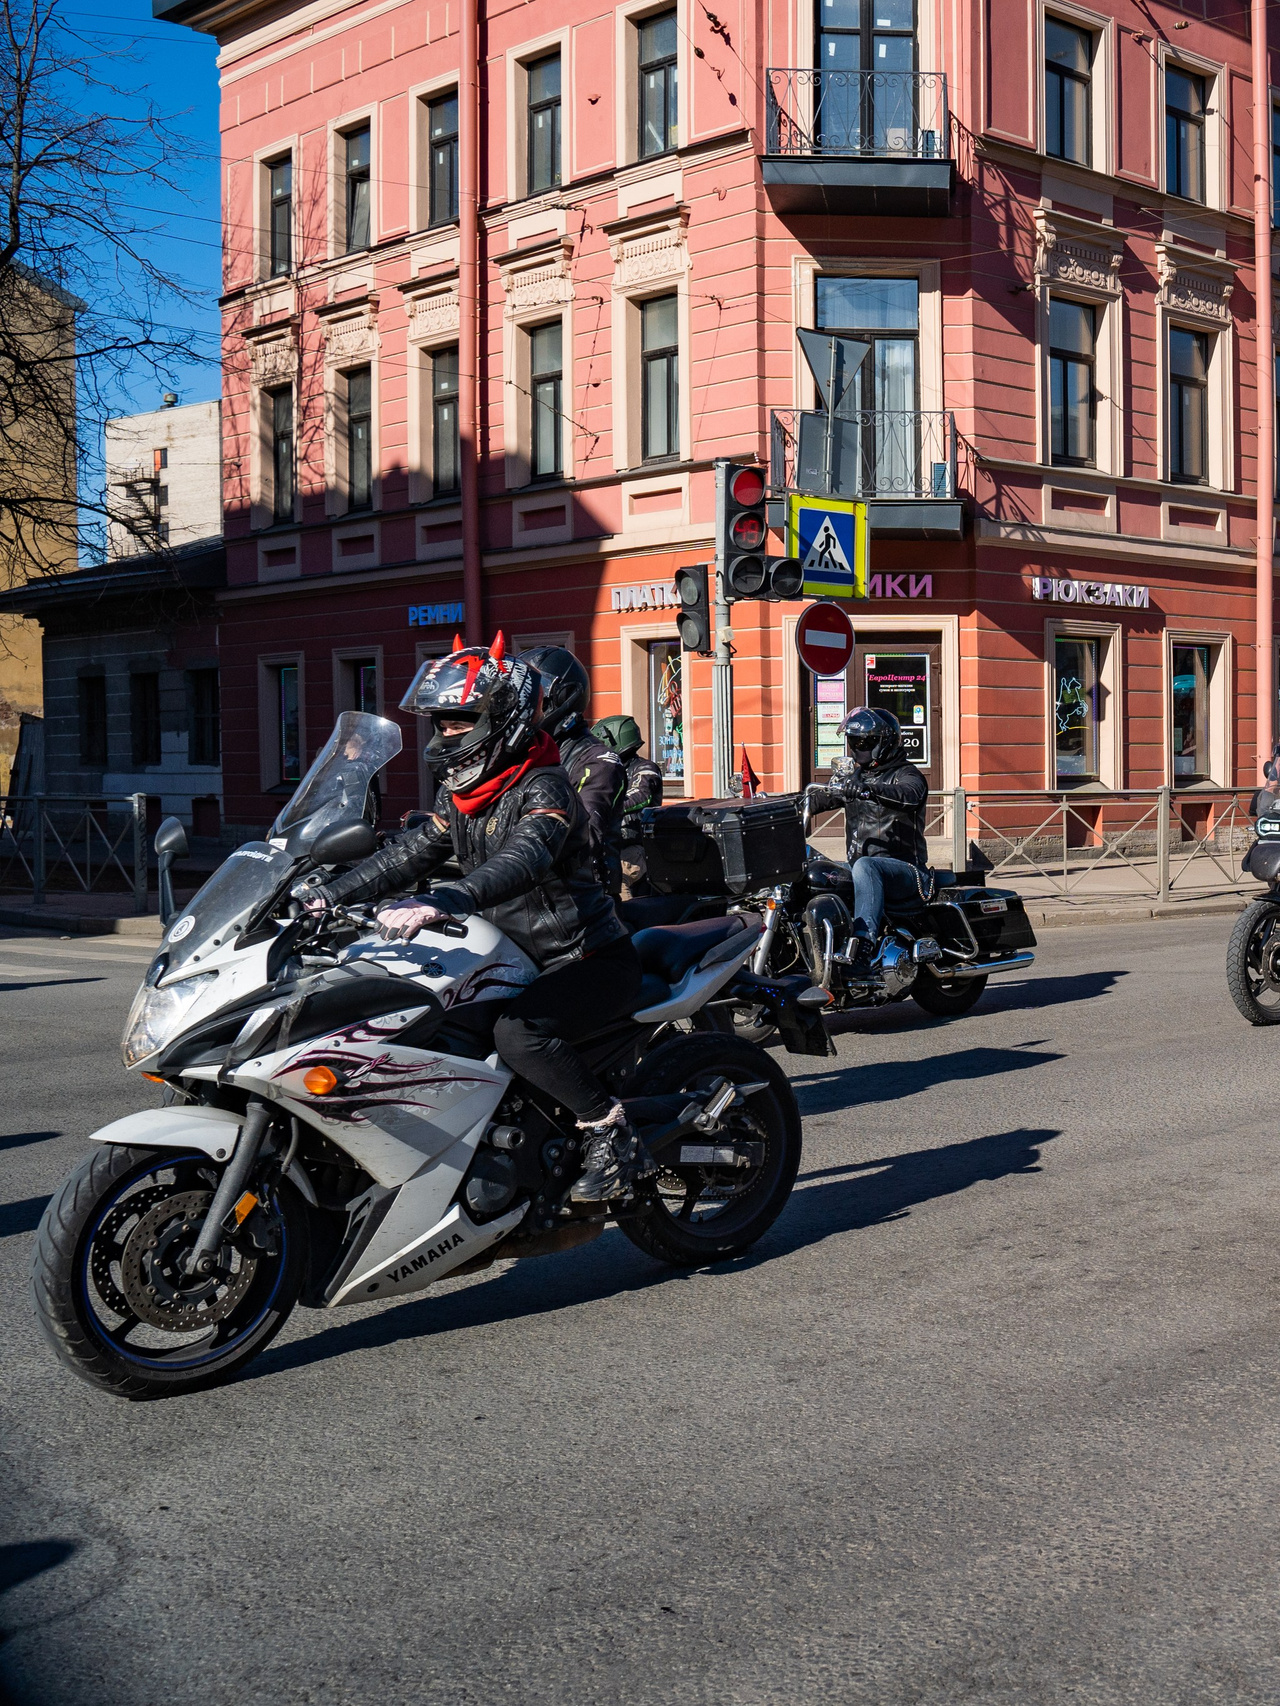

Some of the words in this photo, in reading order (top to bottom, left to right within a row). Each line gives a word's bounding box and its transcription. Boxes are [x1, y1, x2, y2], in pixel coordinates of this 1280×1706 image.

[1032, 577, 1149, 608] РЮКЗАКИ
[408, 602, 464, 626] РЕМНИ
[903, 738, 920, 748] 20
[386, 1233, 465, 1283] YAMAHA
